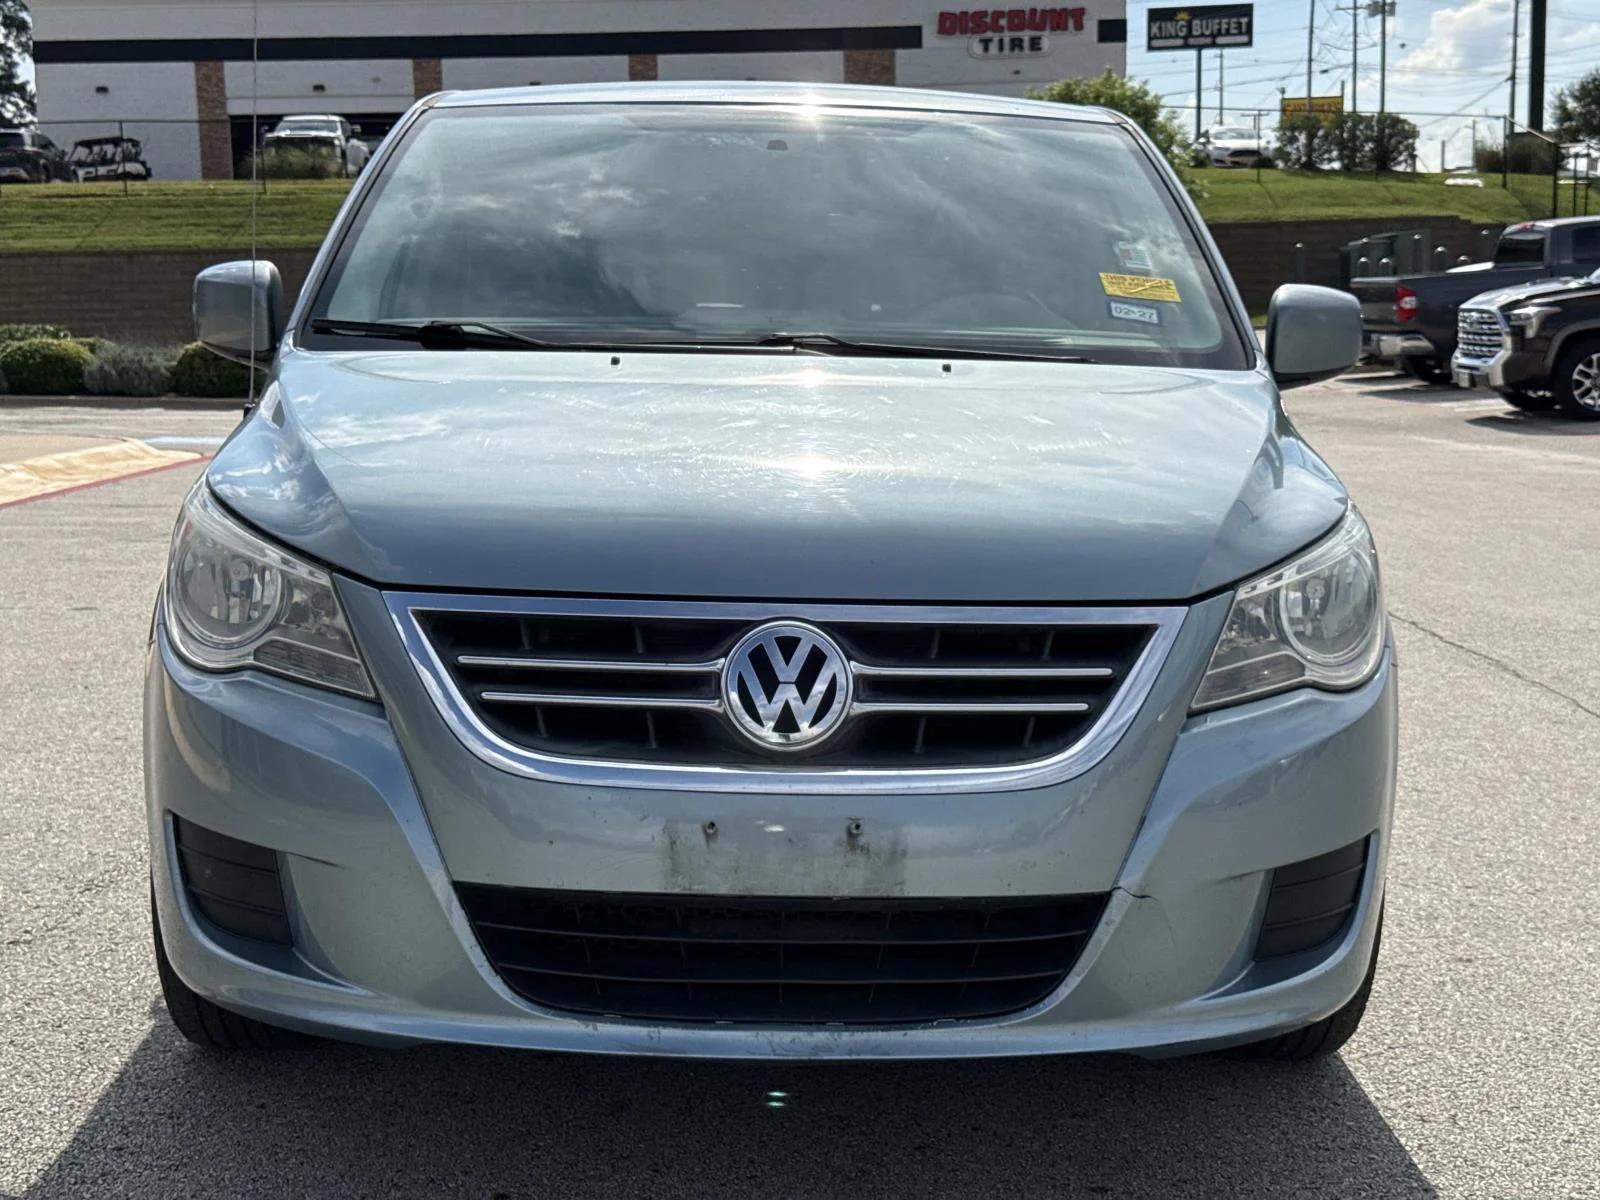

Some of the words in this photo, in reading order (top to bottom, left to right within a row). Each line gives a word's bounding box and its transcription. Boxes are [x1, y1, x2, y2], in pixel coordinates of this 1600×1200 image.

[938, 8, 1085, 35] DISCOUNT
[1151, 21, 1187, 38] KING
[1191, 17, 1249, 36] BUFFET
[978, 37, 1042, 53] TIRE
[1114, 305, 1154, 320] 02-27
